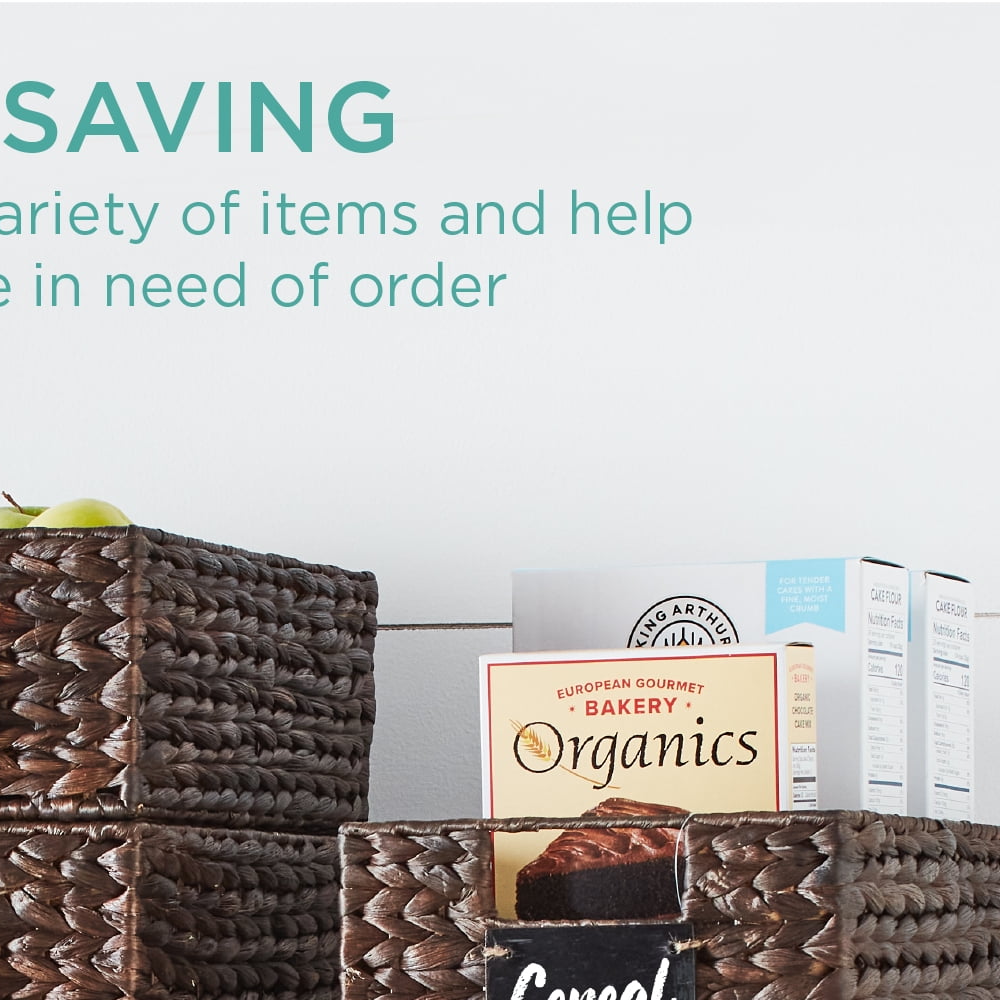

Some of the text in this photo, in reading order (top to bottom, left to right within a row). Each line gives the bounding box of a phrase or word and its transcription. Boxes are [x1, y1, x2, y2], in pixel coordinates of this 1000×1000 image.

[779, 575, 831, 585] FOR TENDER
[804, 585, 826, 593] WITH
[870, 588, 902, 606] CAKE FLOUR
[935, 600, 967, 618] CAKE FLOUR
[635, 603, 732, 648] KING ARTHUR
[868, 611, 890, 628] Nutrition
[556, 678, 706, 701] EUROPEAN GOURMET
[584, 697, 678, 717] BAKERY
[513, 716, 758, 791] Organics
